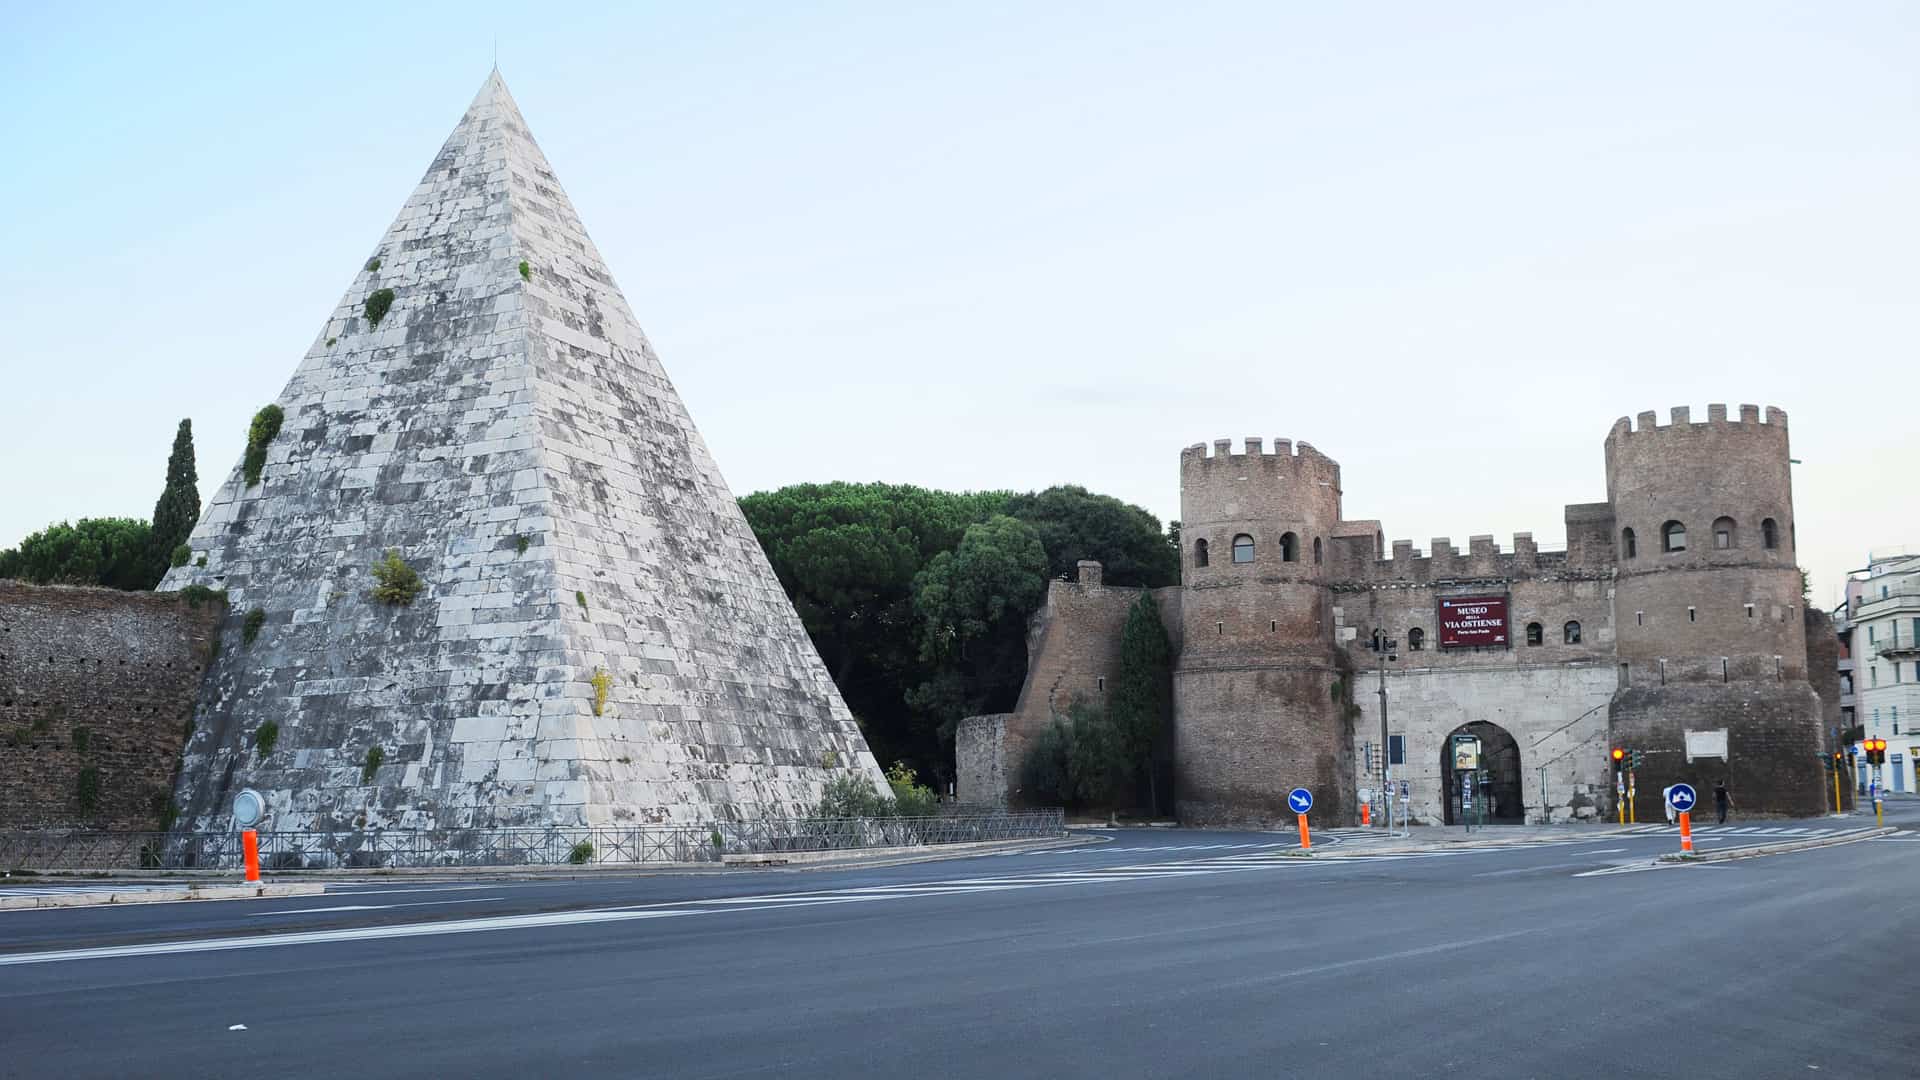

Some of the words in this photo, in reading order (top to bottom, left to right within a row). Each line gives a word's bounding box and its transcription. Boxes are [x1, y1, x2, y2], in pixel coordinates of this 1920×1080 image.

[1457, 606, 1488, 615] MUSEO
[1444, 621, 1460, 629] VIA
[1461, 619, 1503, 628] OSTIENSE
